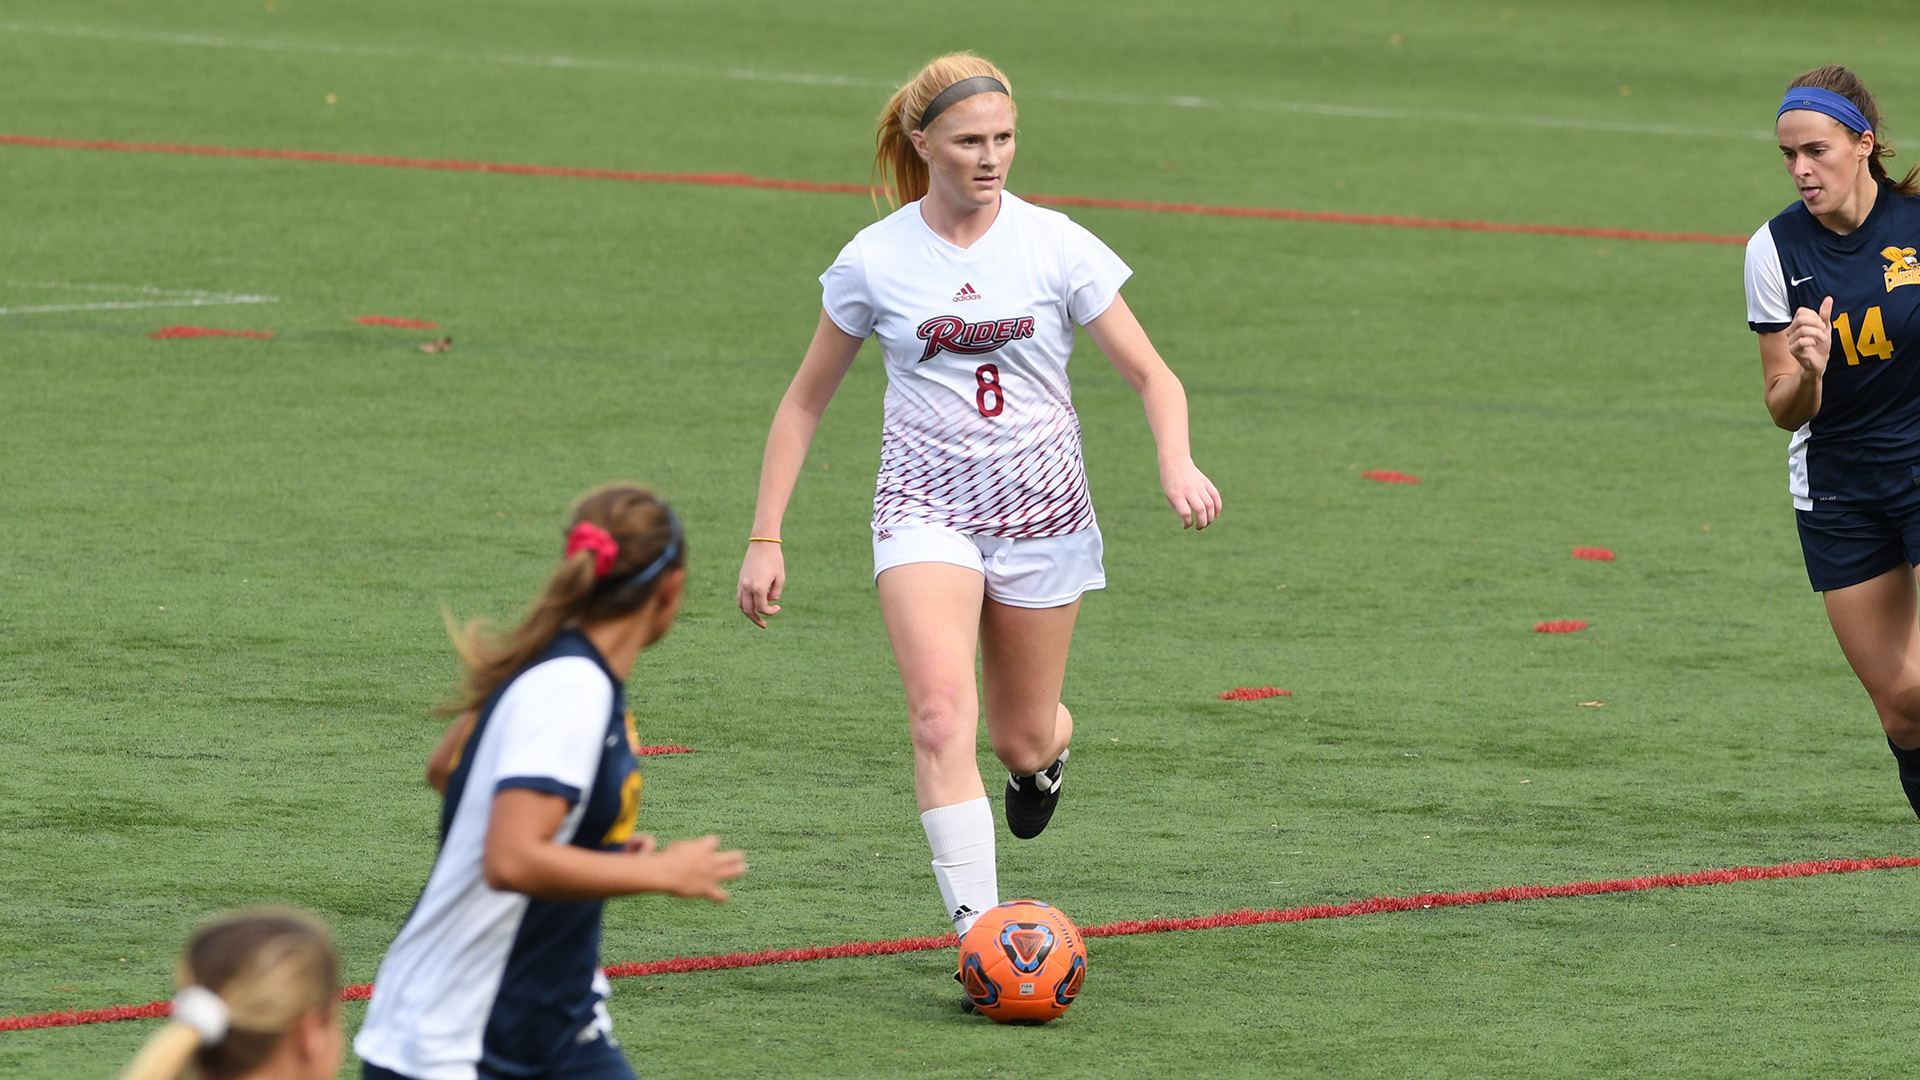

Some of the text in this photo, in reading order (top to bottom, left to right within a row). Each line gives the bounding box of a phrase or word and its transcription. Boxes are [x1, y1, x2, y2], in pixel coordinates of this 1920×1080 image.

[952, 293, 982, 303] adidas
[916, 315, 1035, 364] RIDER
[1832, 305, 1895, 366] 14
[975, 363, 1004, 418] 8
